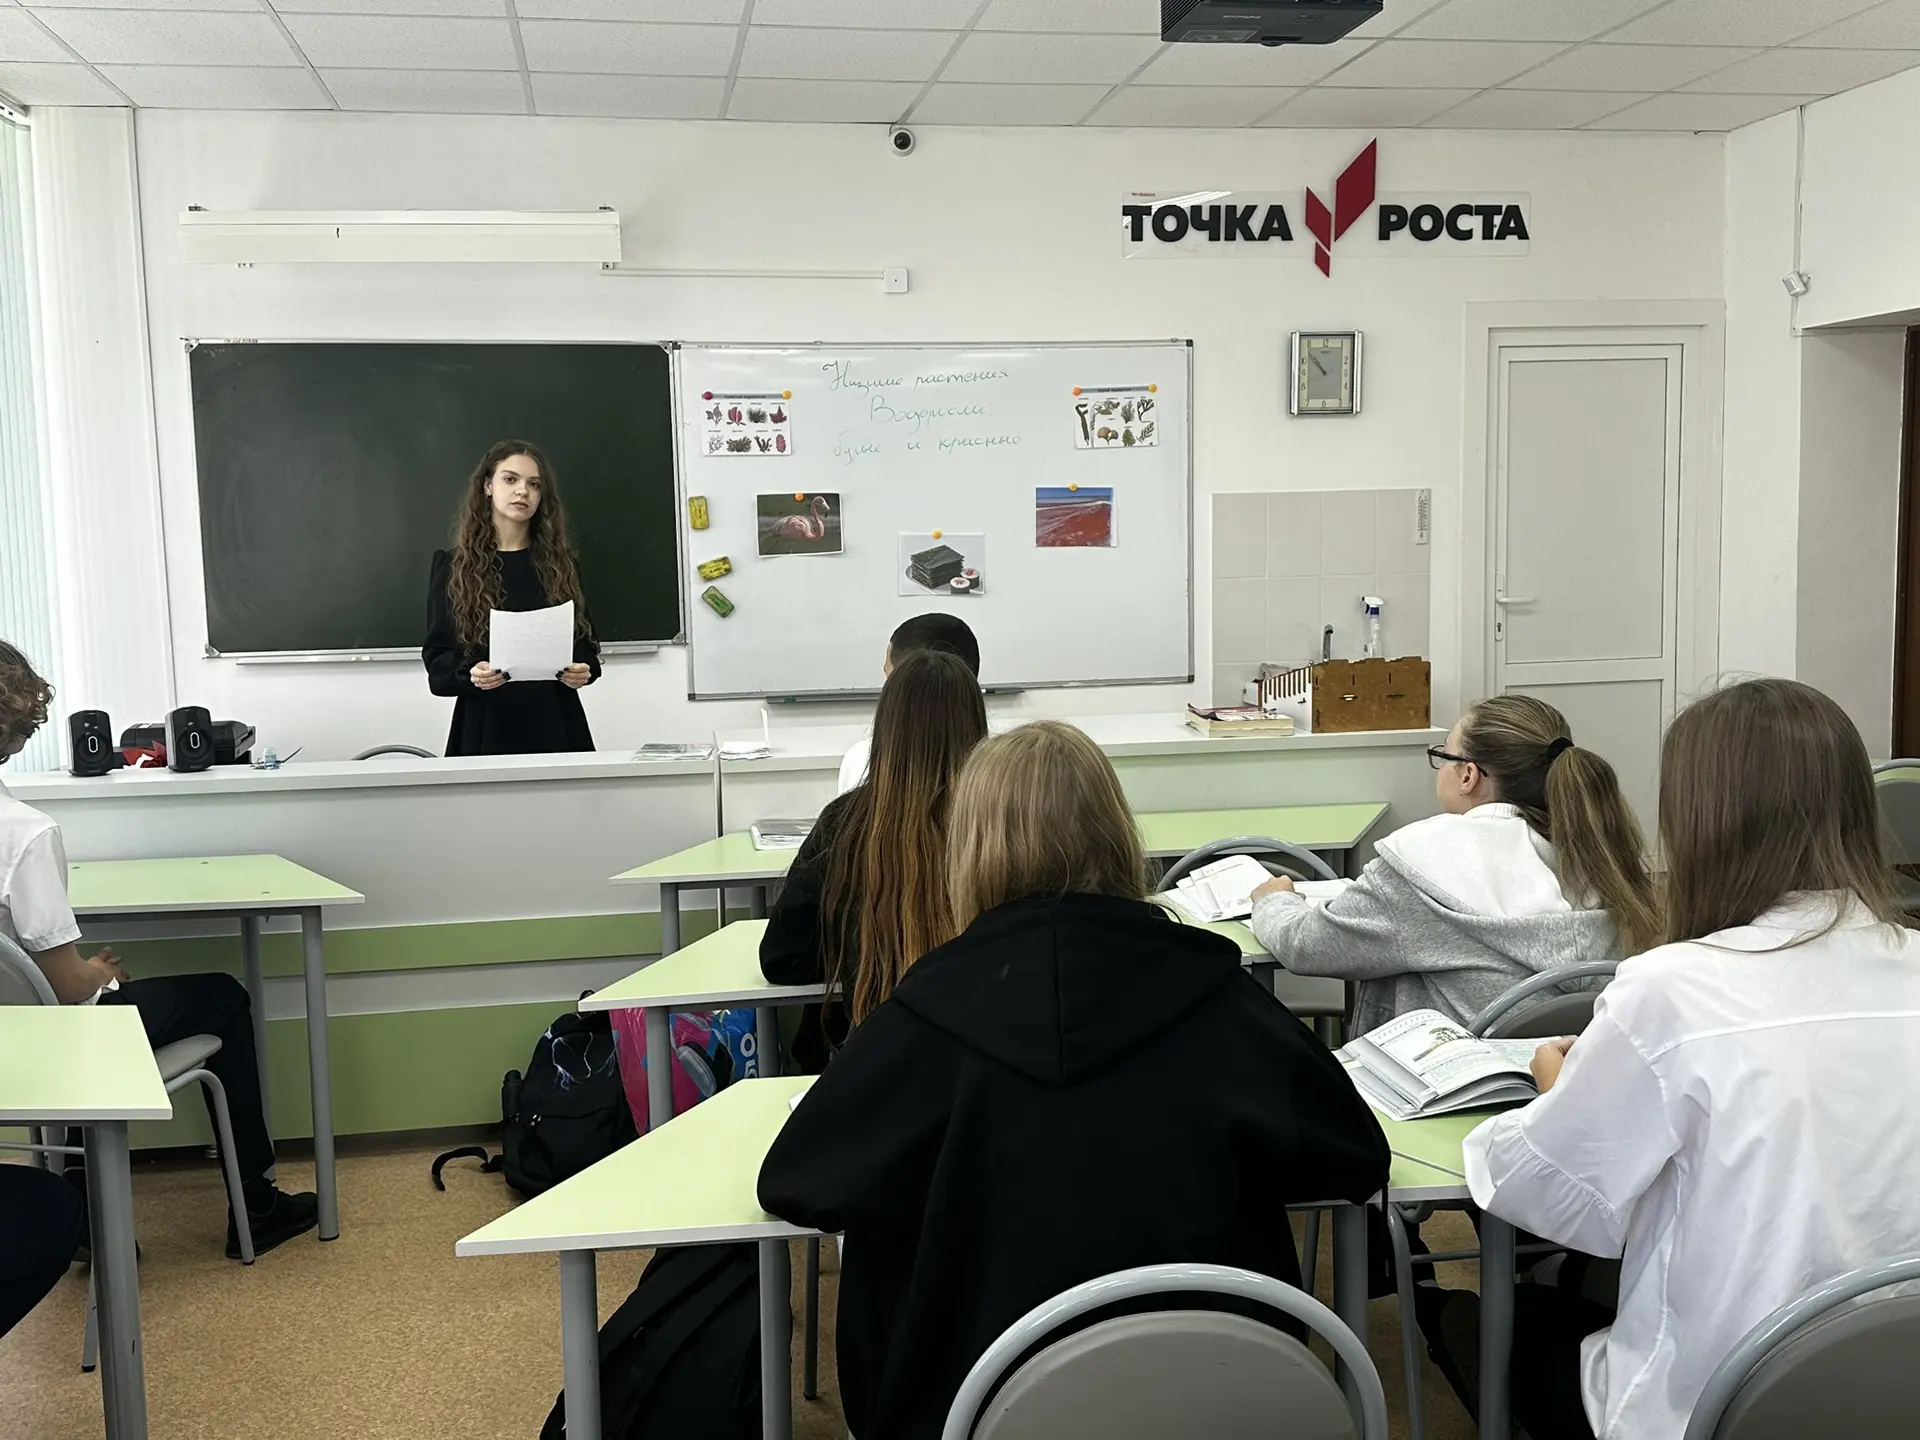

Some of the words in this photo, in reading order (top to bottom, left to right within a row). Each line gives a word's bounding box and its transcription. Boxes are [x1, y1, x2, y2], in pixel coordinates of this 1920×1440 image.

[1122, 204, 1293, 243] ТОЧКА
[1378, 203, 1530, 241] РОСТА
[914, 367, 1010, 392] растения
[907, 440, 922, 451] и
[938, 433, 1022, 456] красные
